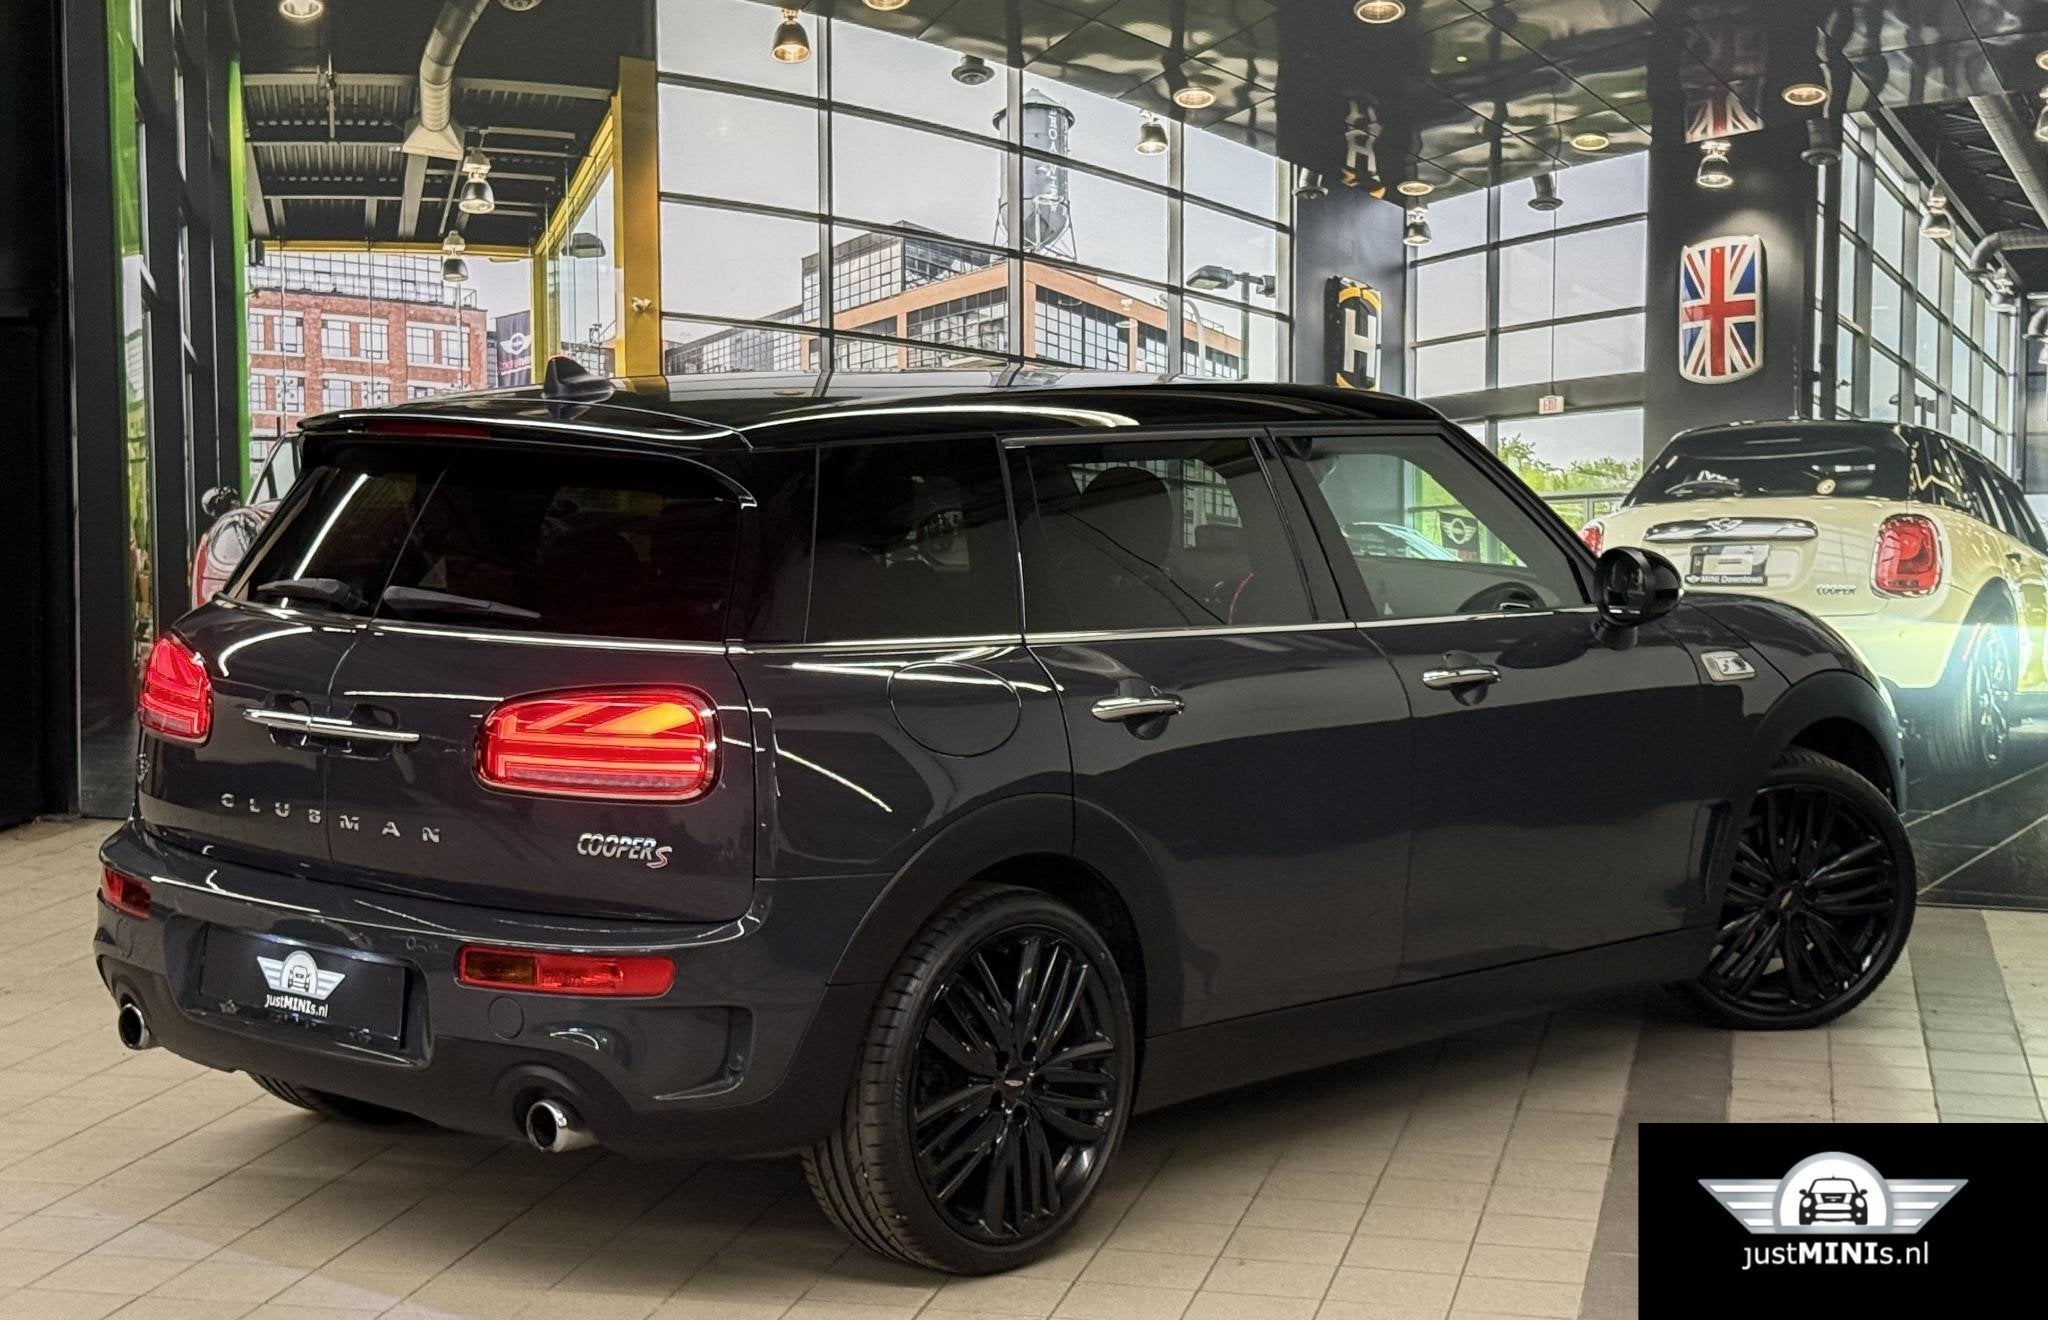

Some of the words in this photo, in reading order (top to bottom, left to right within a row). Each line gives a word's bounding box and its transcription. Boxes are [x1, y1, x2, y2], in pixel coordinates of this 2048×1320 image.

[1343, 308, 1377, 378] H
[1816, 583, 1857, 596] COOPER
[221, 793, 441, 843] CLUBMAN
[577, 832, 657, 860] COOPER
[646, 846, 673, 869] S
[264, 994, 329, 1018] justMINIs.nl
